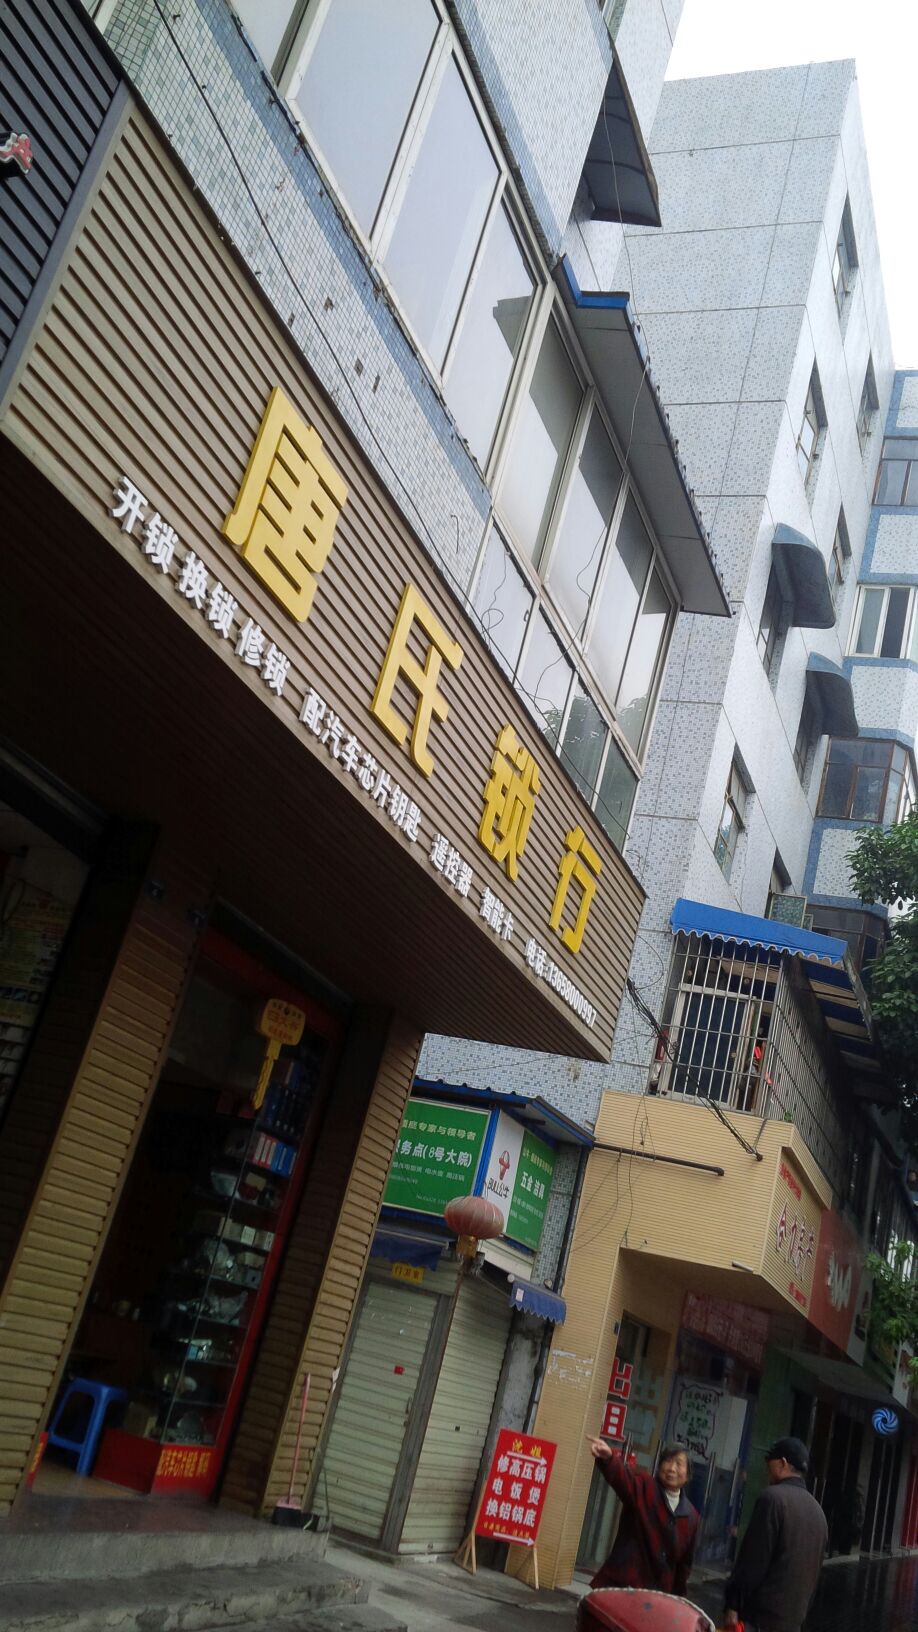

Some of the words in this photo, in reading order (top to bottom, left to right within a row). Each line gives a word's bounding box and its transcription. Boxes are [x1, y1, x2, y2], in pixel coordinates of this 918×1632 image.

[108, 476, 180, 574] 开锁
[175, 552, 240, 640] 换锁
[234, 618, 292, 697] 修锁
[299, 687, 422, 843] 配汽车芯片钥匙
[428, 833, 474, 898] 遥控器
[480, 887, 515, 942] 智能卡
[497, 1455, 548, 1484] 修高压锅
[485, 1498, 537, 1528] 换铝锅底
